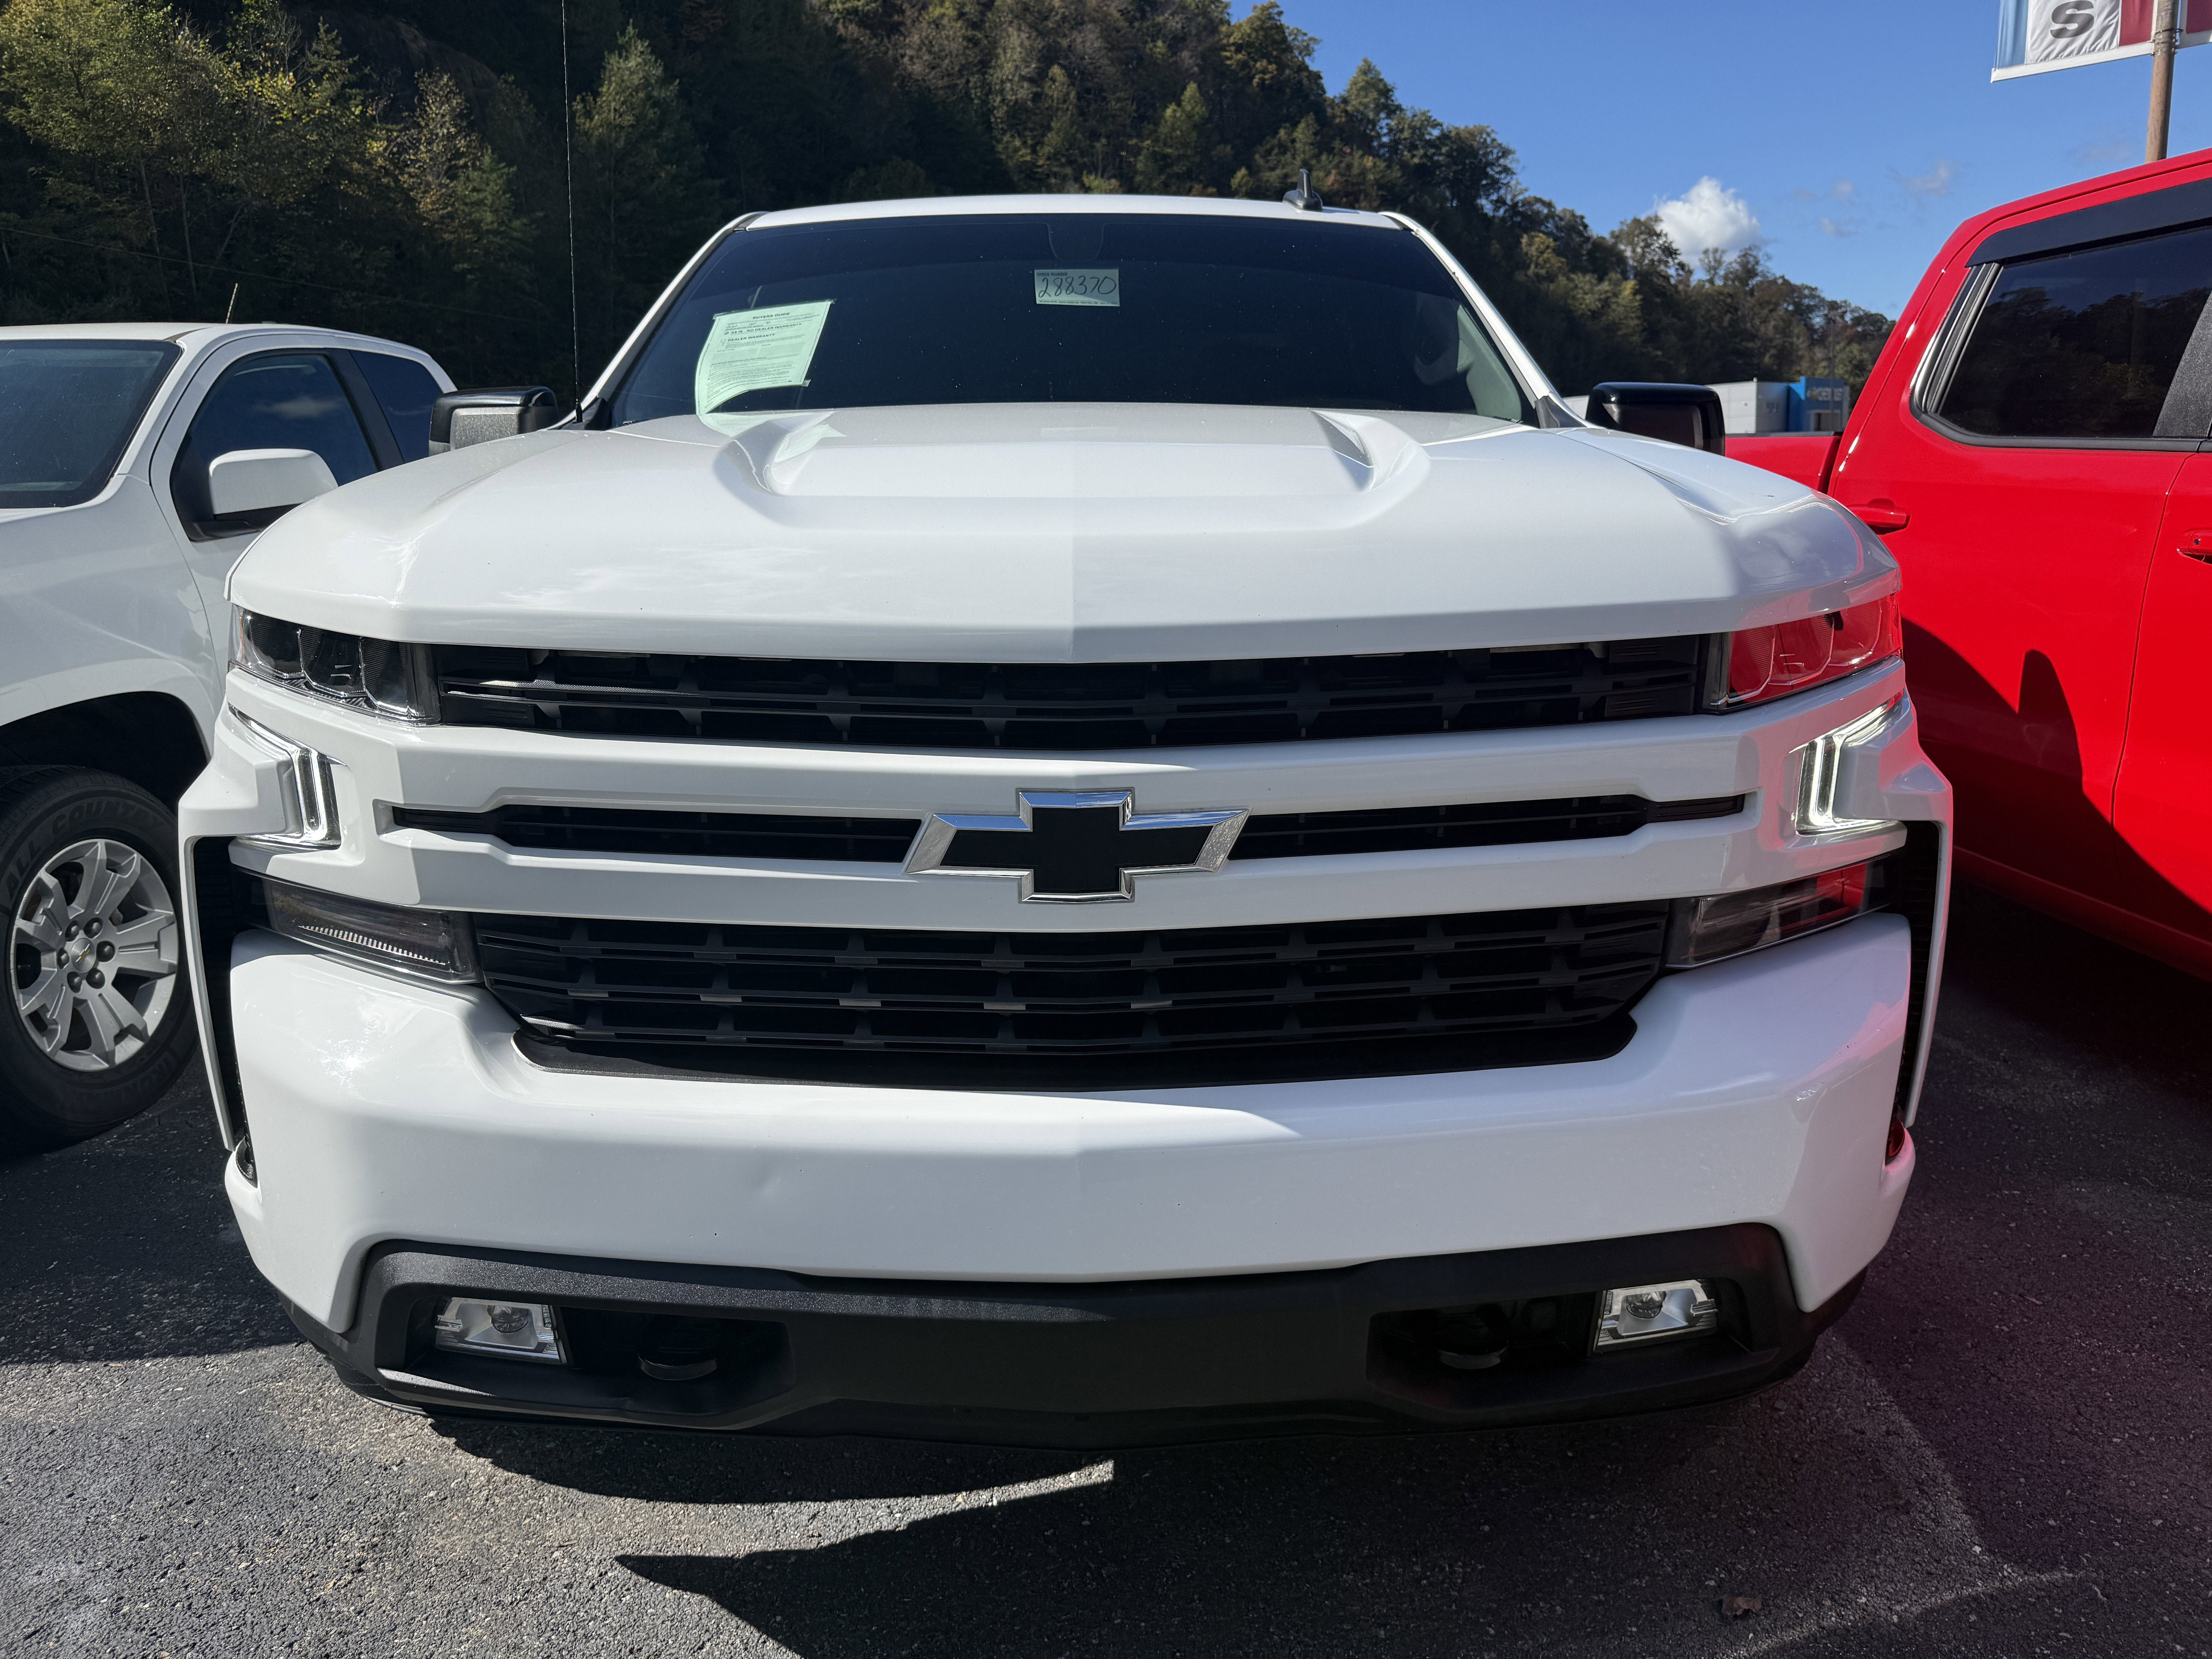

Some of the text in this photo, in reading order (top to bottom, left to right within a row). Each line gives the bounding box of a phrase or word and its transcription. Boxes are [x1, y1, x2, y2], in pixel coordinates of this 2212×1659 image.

[2050, 0, 2094, 39] S
[1038, 275, 1117, 298] 288370
[5, 839, 41, 900] ALL
